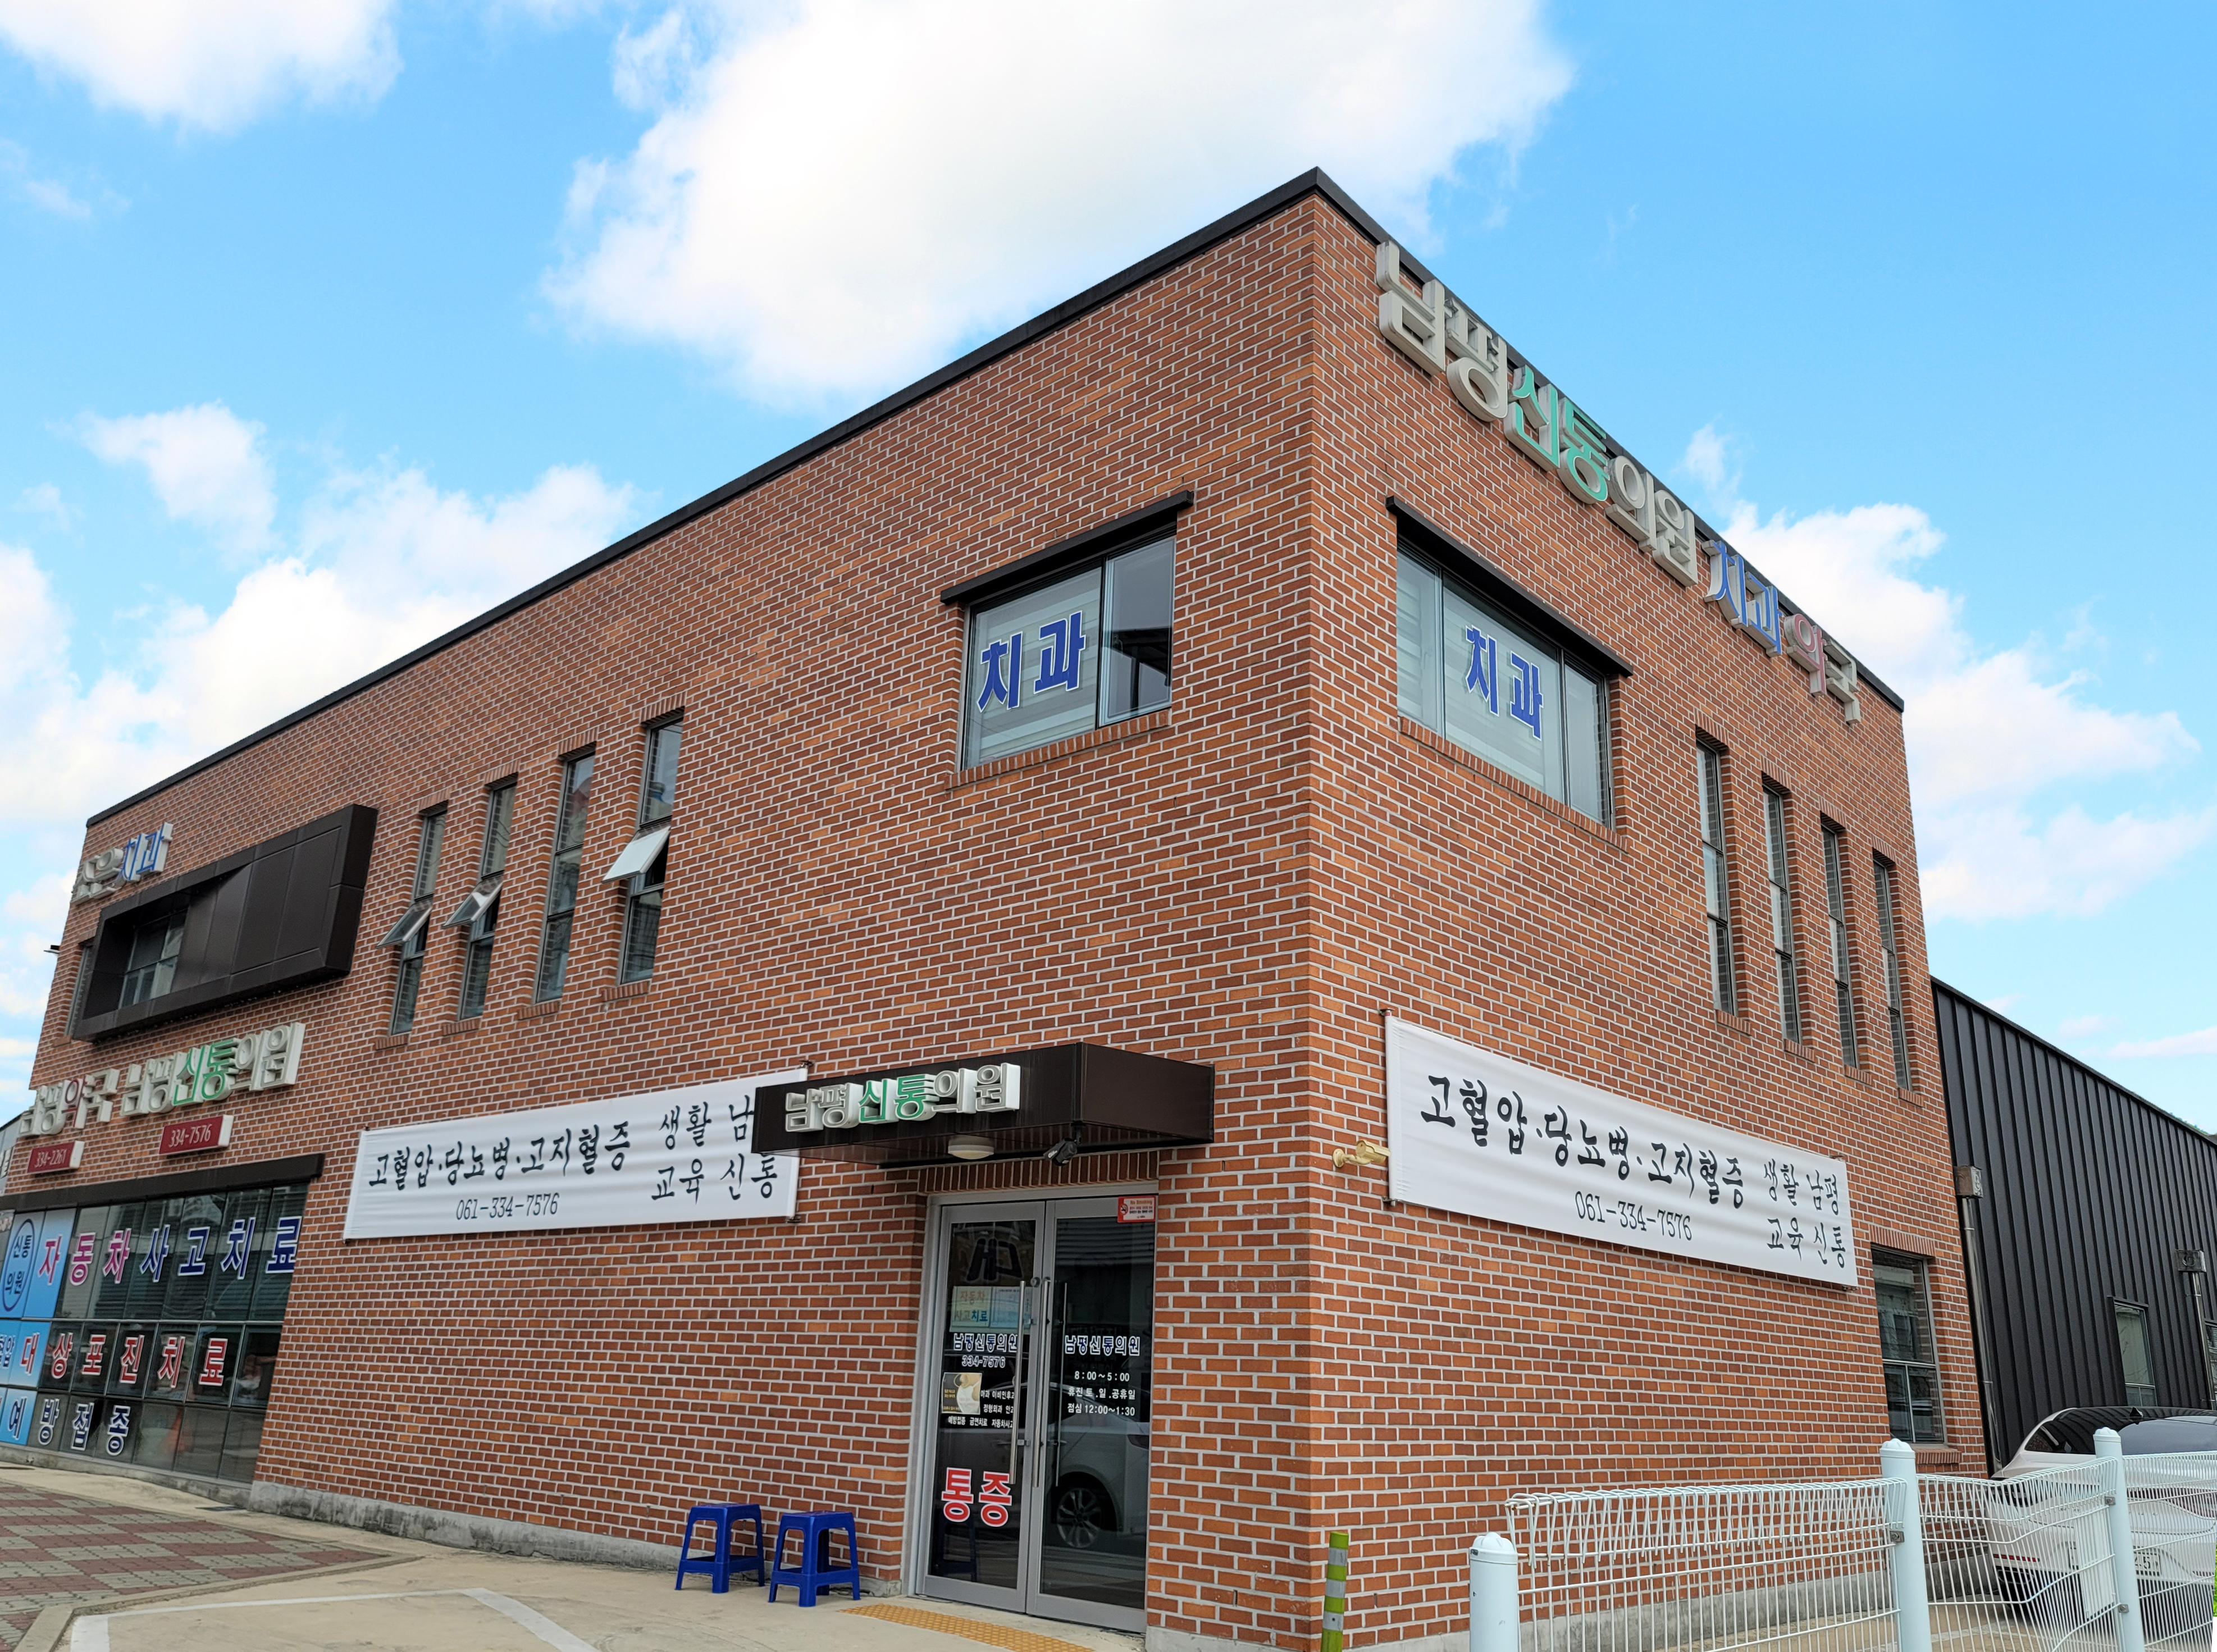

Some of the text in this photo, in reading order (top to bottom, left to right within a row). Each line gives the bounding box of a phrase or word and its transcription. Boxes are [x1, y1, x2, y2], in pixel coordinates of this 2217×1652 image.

[1376, 240, 1861, 725] 남평신통의원 치과 약국
[976, 610, 1086, 713] 치과
[1465, 624, 1544, 742] 치과
[19, 1022, 307, 1137] 남평약국 남평신통의원
[785, 1061, 1021, 1133] 남평신통의원
[168, 1124, 213, 1148] 334-7576
[658, 1094, 754, 1151] 생활 남
[651, 1158, 705, 1206] 교육
[1763, 1158, 1839, 1216] 생활 남평
[456, 1192, 560, 1221] 061-334-7576
[1575, 1190, 1693, 1241] 061-334-7576
[13, 1235, 32, 1258] 신통
[1766, 1217, 1804, 1262] 교육
[5, 1271, 25, 1294] 의원
[960, 1290, 986, 1304] 자동차
[961, 1355, 1006, 1368] 334-7576
[1065, 1335, 1141, 1356] 남평신통의원
[980, 1390, 990, 1398] 아과
[983, 1404, 1002, 1414] 정형외과
[1068, 1386, 1083, 1397] 휴진
[1068, 1403, 1082, 1414] 점심
[8, 1395, 131, 1456] 예방접종
[948, 1416, 966, 1425] 예방접종
[970, 1417, 988, 1426] 금연치료
[941, 1467, 1012, 1527] 통증
